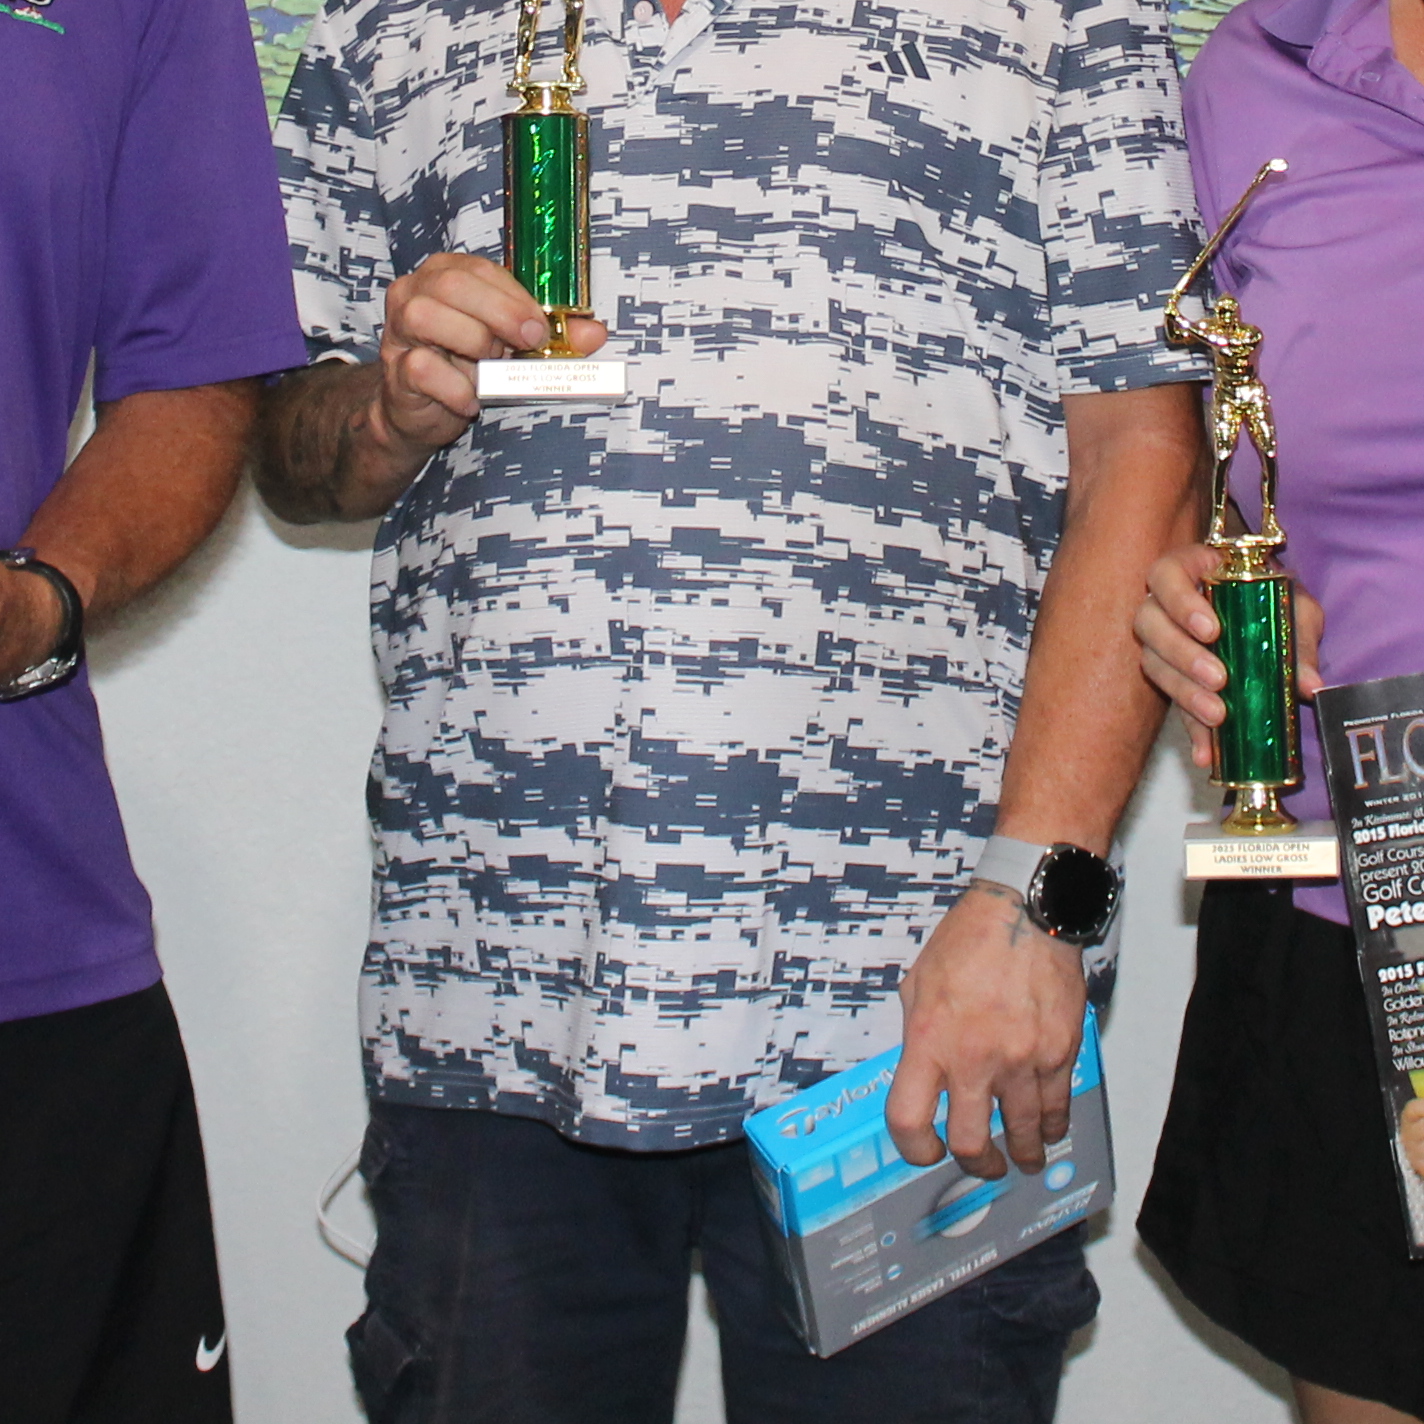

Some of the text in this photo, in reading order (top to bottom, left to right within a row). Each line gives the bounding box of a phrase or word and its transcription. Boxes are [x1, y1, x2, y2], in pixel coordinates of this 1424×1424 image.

[530, 363, 570, 372] FLORIDA
[573, 363, 600, 371] OPEN
[541, 374, 563, 382] LOW
[566, 374, 597, 382] GROSS
[1414, 808, 1424, 818] at
[1353, 826, 1387, 844] 2015
[1238, 843, 1280, 853] FLORIDA
[1282, 843, 1310, 852] OPEN
[1214, 854, 1309, 864] LADIES LOW GROSS
[1358, 849, 1383, 867] Golf
[1241, 865, 1282, 874] WINNER
[1360, 864, 1408, 885] present
[1363, 878, 1403, 903] Golf
[1377, 963, 1413, 983] 2015
[973, 1248, 998, 1269] SOFT
[911, 1278, 945, 1303] EASIER
